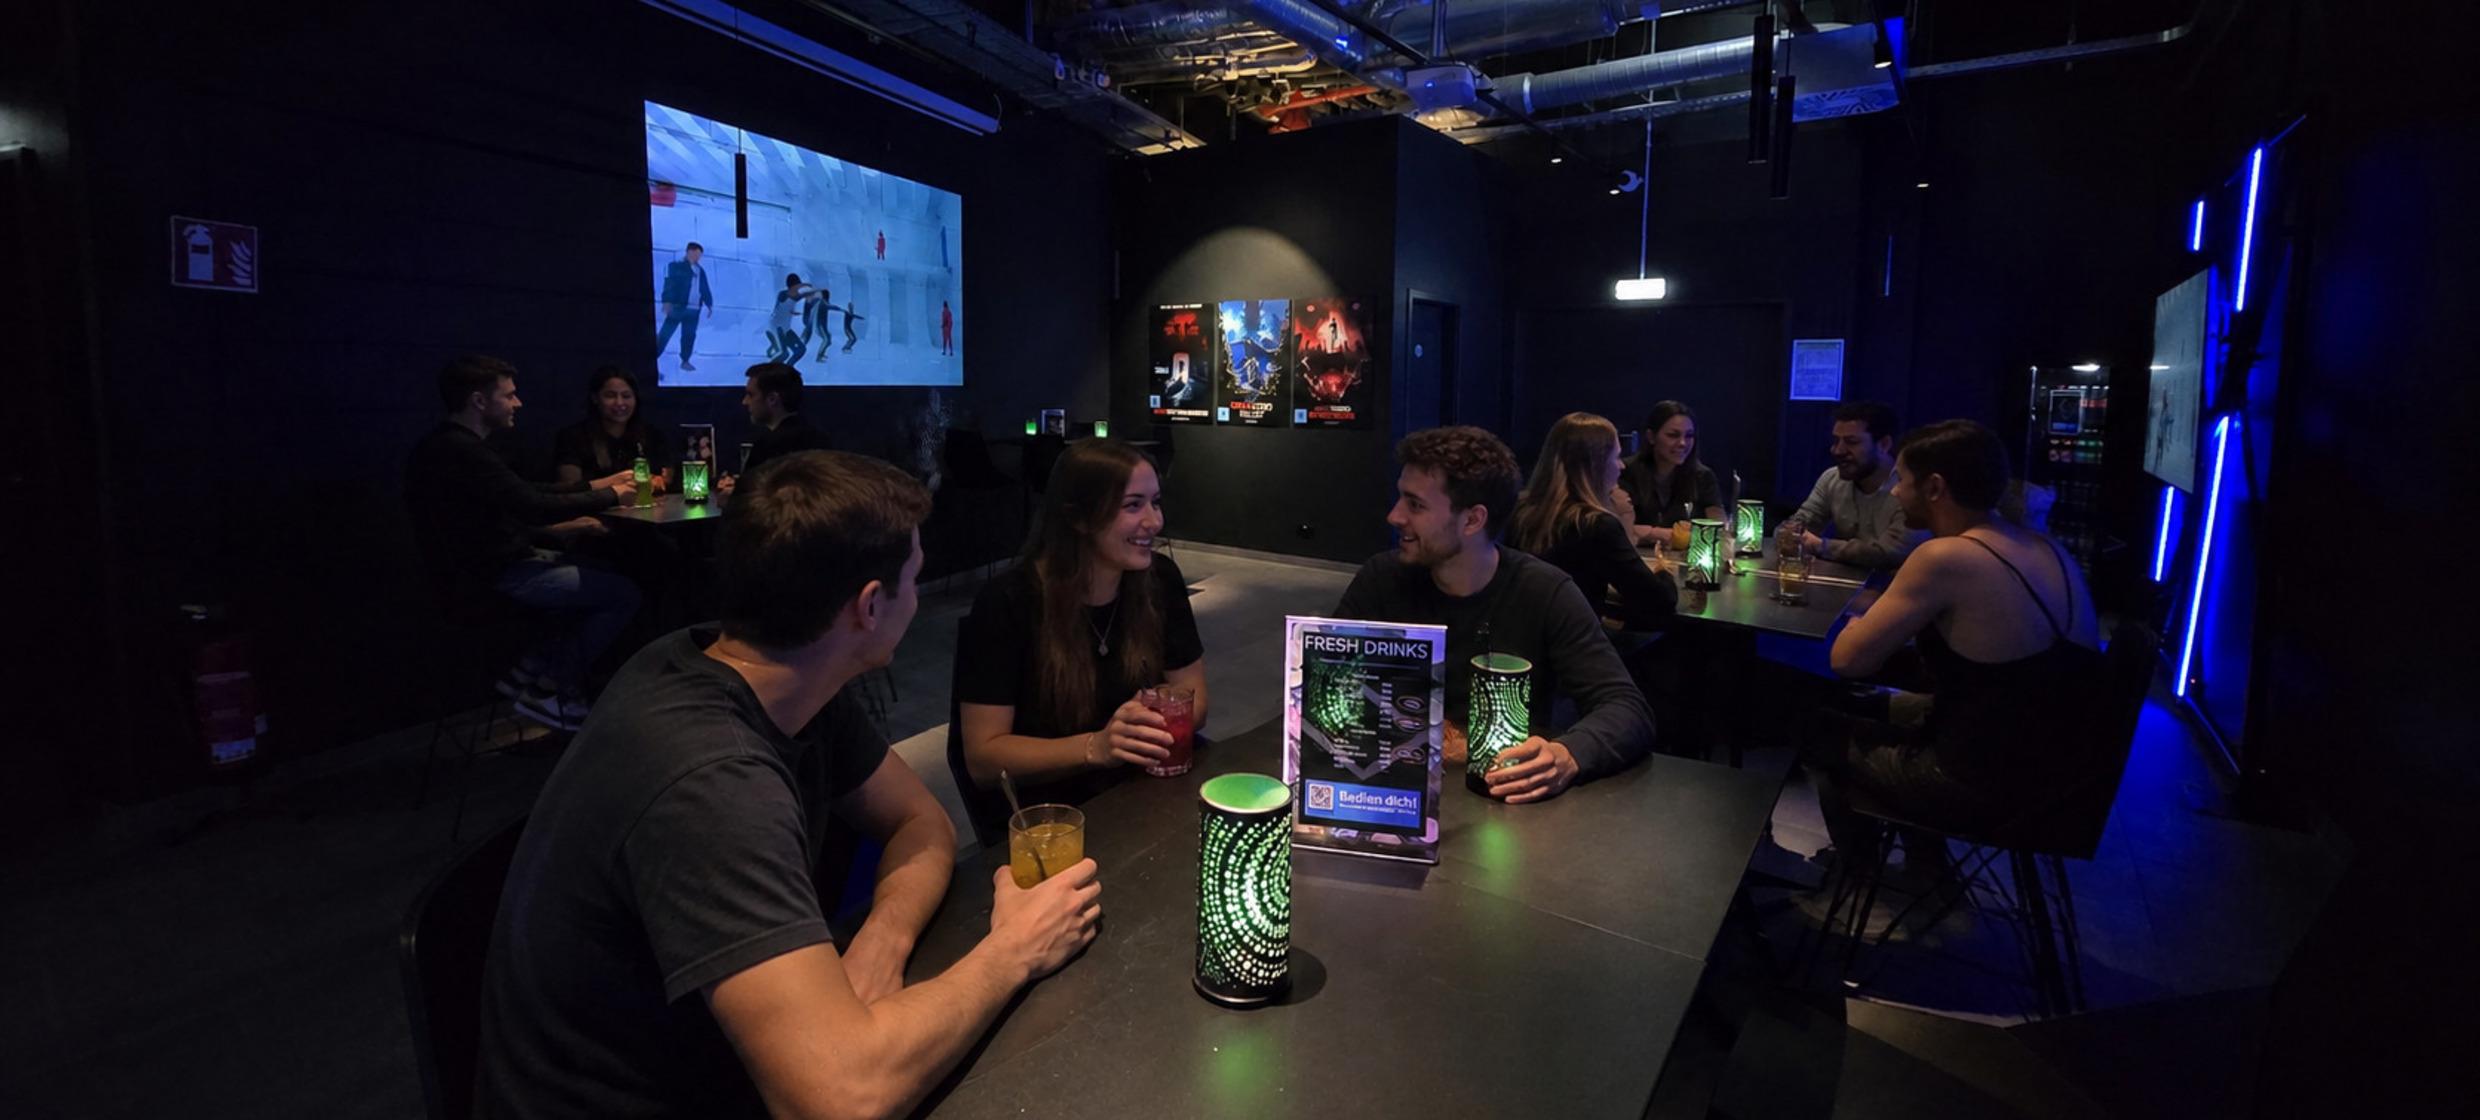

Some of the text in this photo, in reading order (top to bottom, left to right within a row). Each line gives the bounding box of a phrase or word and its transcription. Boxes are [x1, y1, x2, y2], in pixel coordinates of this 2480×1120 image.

[1304, 635, 1429, 659] FRESH DRINKS
[1339, 790, 1384, 806] Bedien
[1385, 795, 1418, 809] dich!
